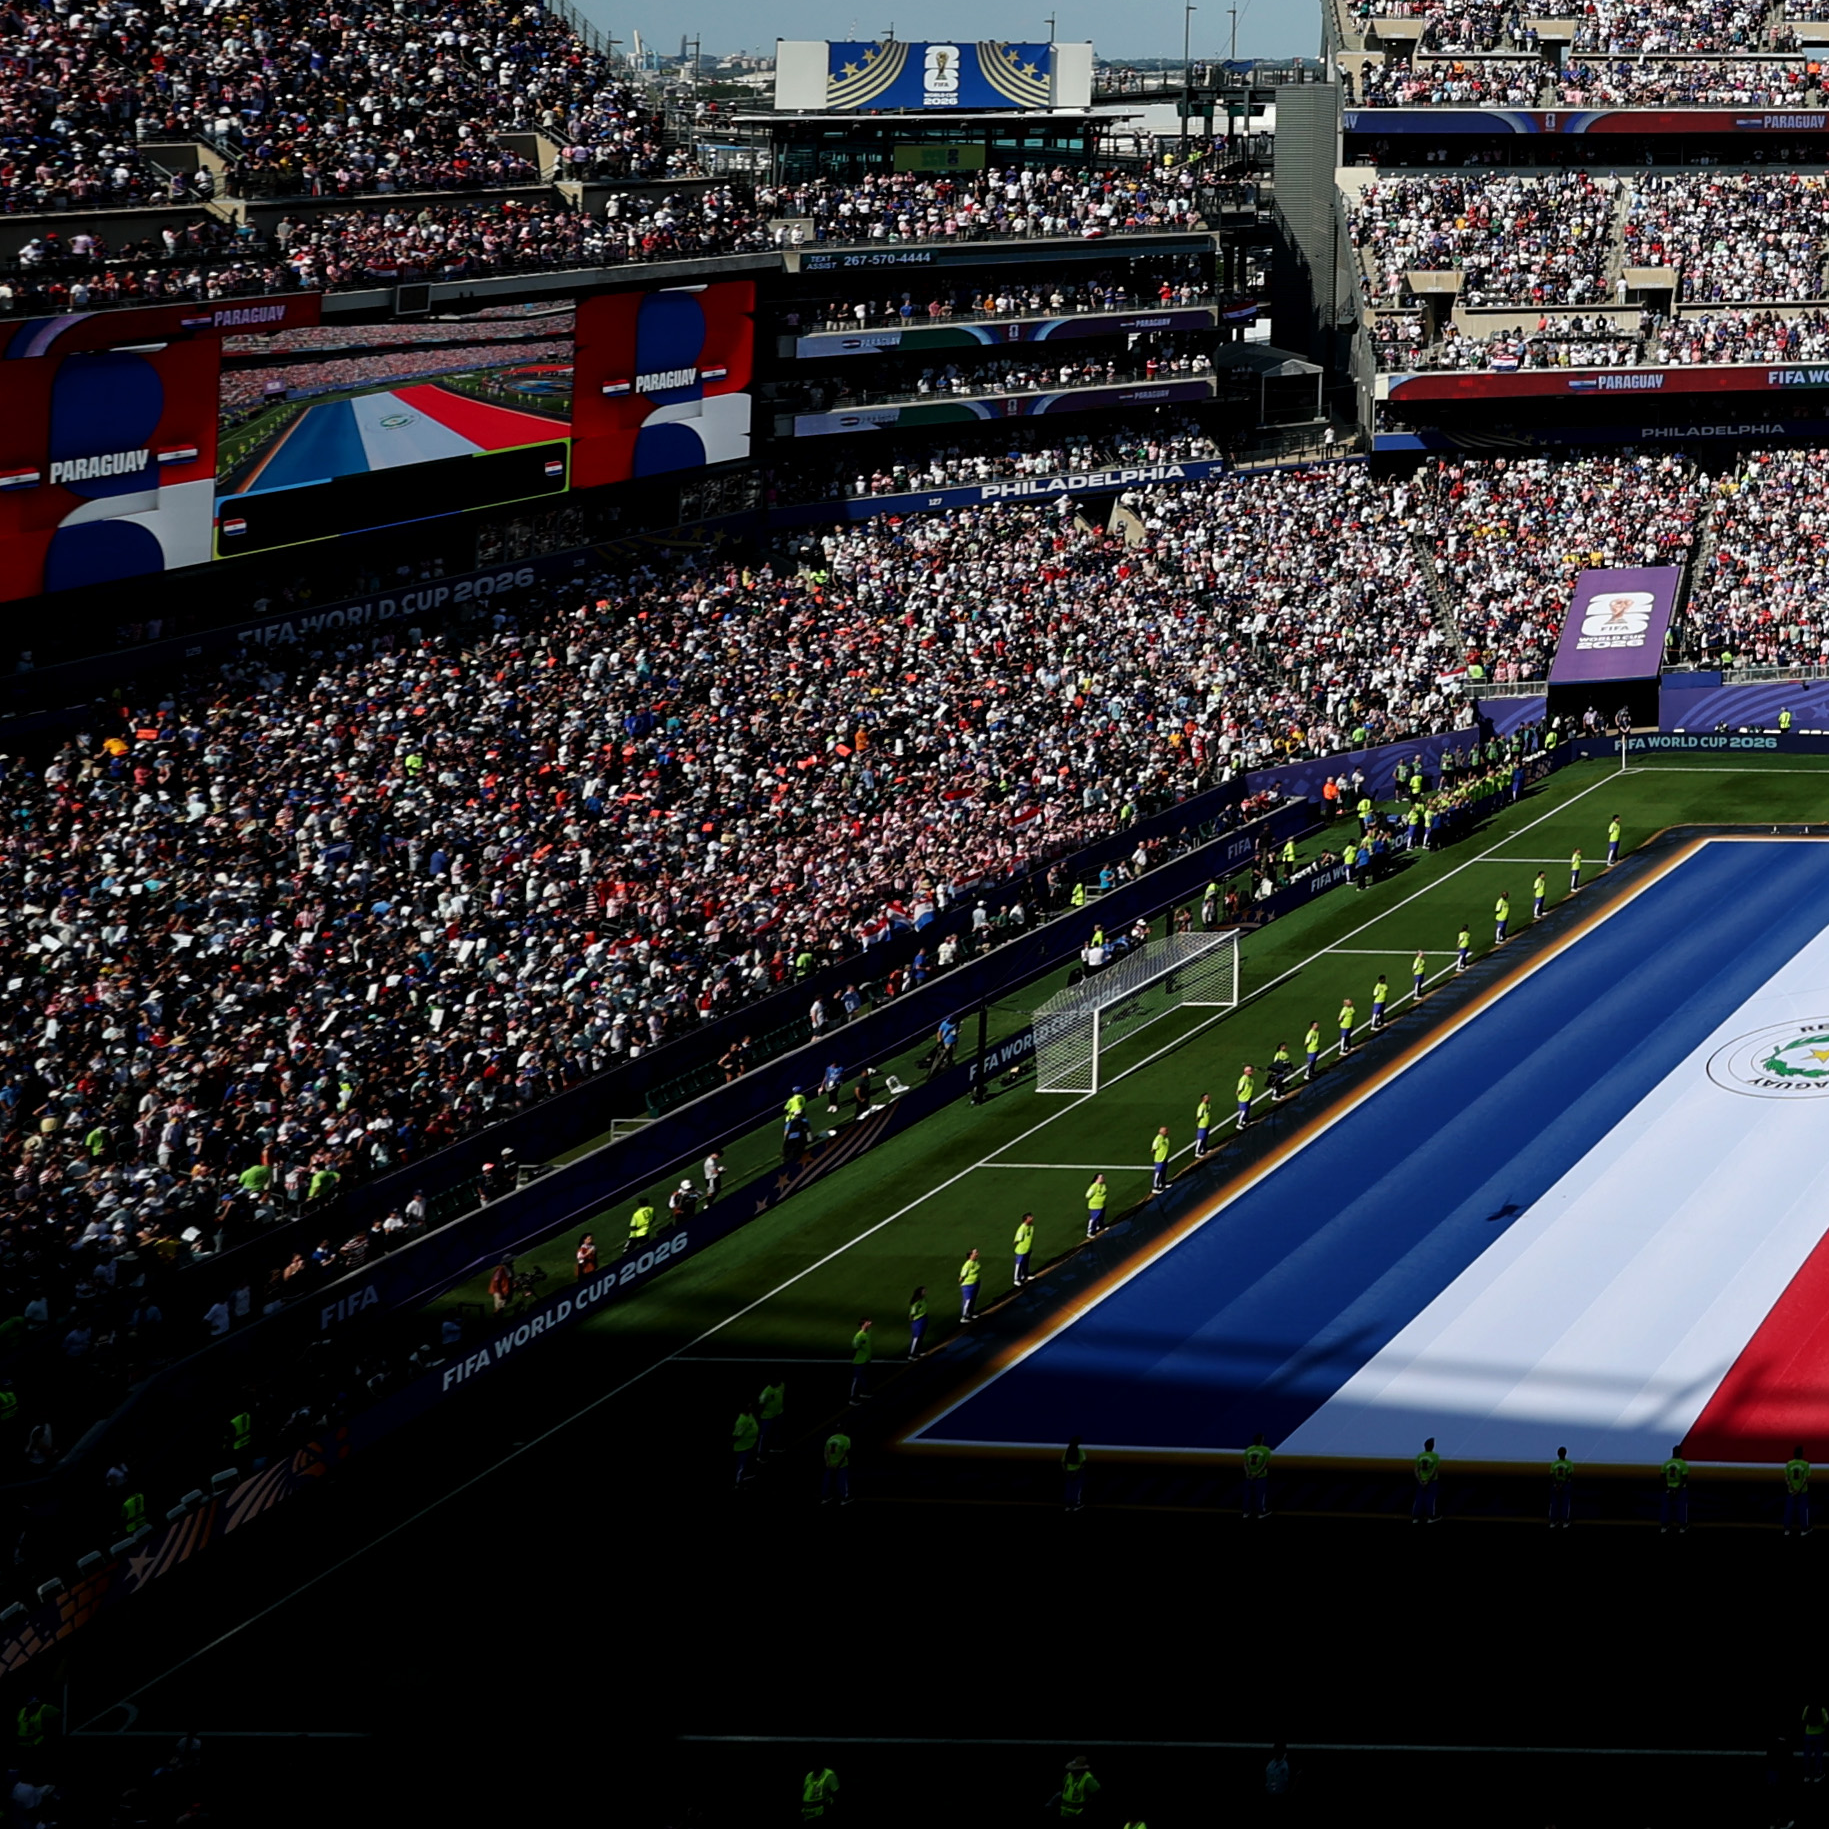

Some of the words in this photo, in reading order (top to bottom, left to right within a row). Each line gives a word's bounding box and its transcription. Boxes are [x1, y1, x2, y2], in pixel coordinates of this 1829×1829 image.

[923, 97, 959, 106] 2026
[1763, 114, 1826, 128] PARAGUAY
[807, 262, 838, 270] ASSIST
[843, 252, 931, 267] 267-570-4444
[213, 304, 287, 327] PARAGUAY
[1135, 317, 1172, 328] PARAGUAY
[635, 366, 697, 394] PARAGUAY
[1598, 374, 1664, 390] PARAGUAY
[1768, 370, 1805, 385] FIFA
[1133, 390, 1171, 401] PARAGUAY
[1641, 423, 1786, 438] PHILADELPHIA
[49, 448, 150, 485] PARAGUAY
[980, 464, 1186, 501] PHILADELPHIA
[237, 621, 298, 650] FIFA
[301, 599, 397, 631] WORLD
[401, 586, 449, 616] CUP
[453, 566, 535, 604] 2026
[1600, 624, 1629, 632] FIFA
[1575, 639, 1645, 650] 2026
[1578, 634, 1621, 642] WORLD
[1647, 737, 1698, 749] WORLD
[1699, 736, 1727, 748] CUP
[1729, 737, 1777, 749] 2026
[1227, 836, 1252, 860] FIFA
[969, 1053, 998, 1082] FFA
[320, 1284, 379, 1331] FIFA
[441, 1348, 491, 1392] FIFA
[493, 1299, 572, 1360] WORLD
[574, 1272, 617, 1310] CUP
[618, 1230, 688, 1287] 2026
